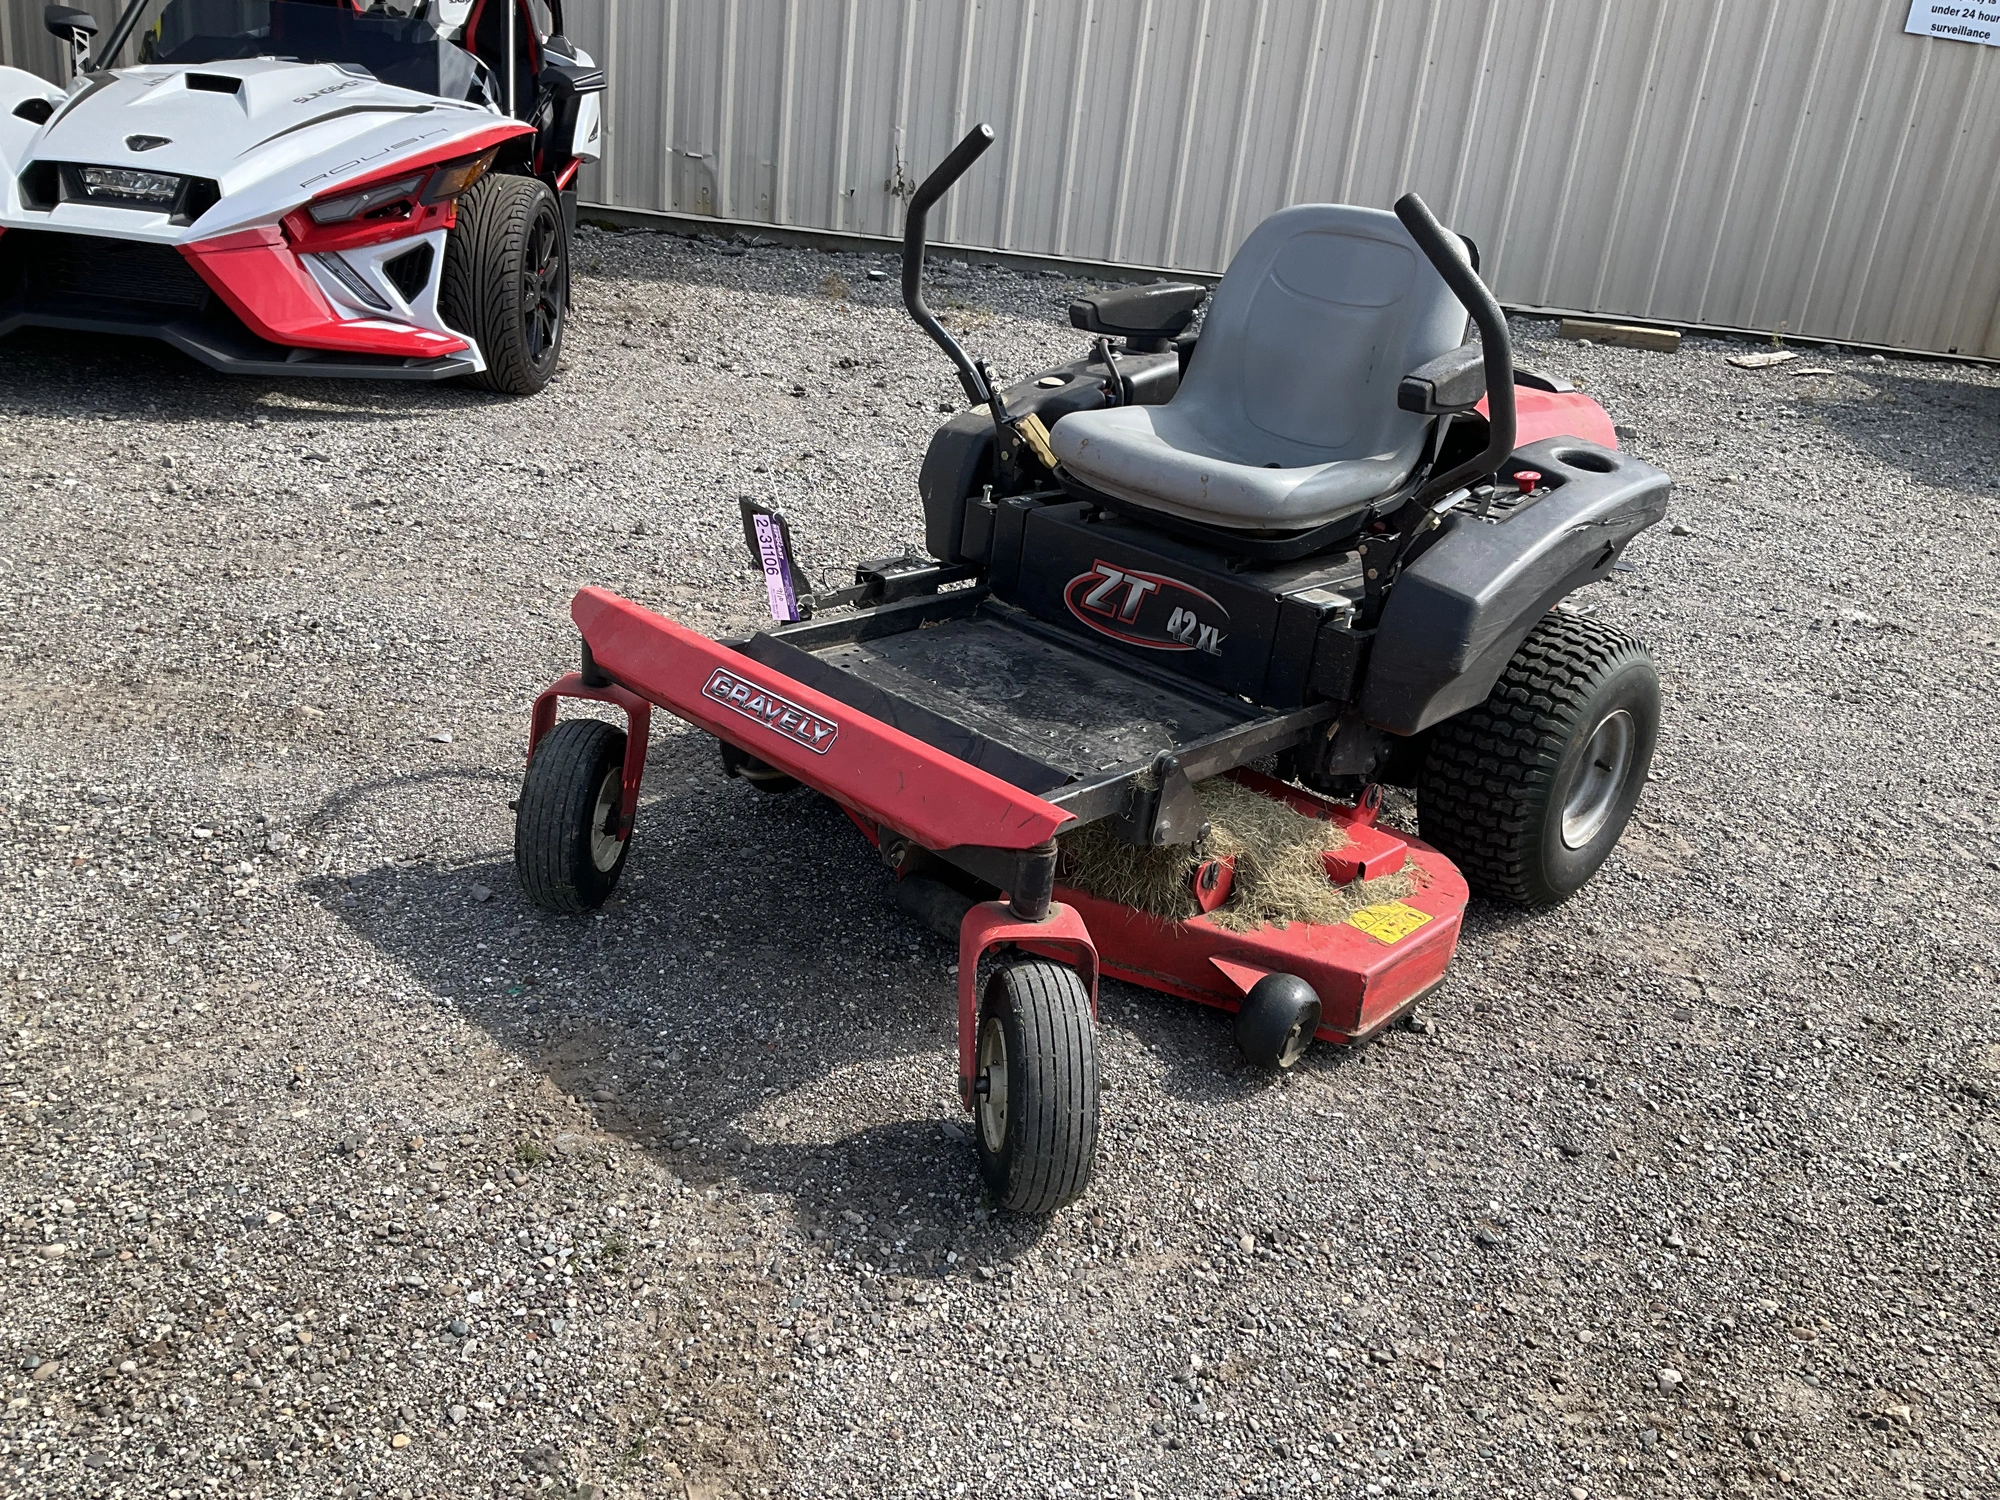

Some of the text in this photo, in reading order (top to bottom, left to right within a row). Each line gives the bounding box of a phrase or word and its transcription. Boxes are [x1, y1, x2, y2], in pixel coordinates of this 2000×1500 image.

[1930, 23, 1991, 39] surveillance
[1931, 5, 1960, 16] under
[1962, 8, 1976, 19] 24
[299, 128, 448, 189] ROUSH
[756, 518, 780, 576] 2-31106
[1082, 560, 1160, 622] ZT
[1166, 606, 1223, 657] 42 XL
[709, 675, 834, 745] GRAVELY
